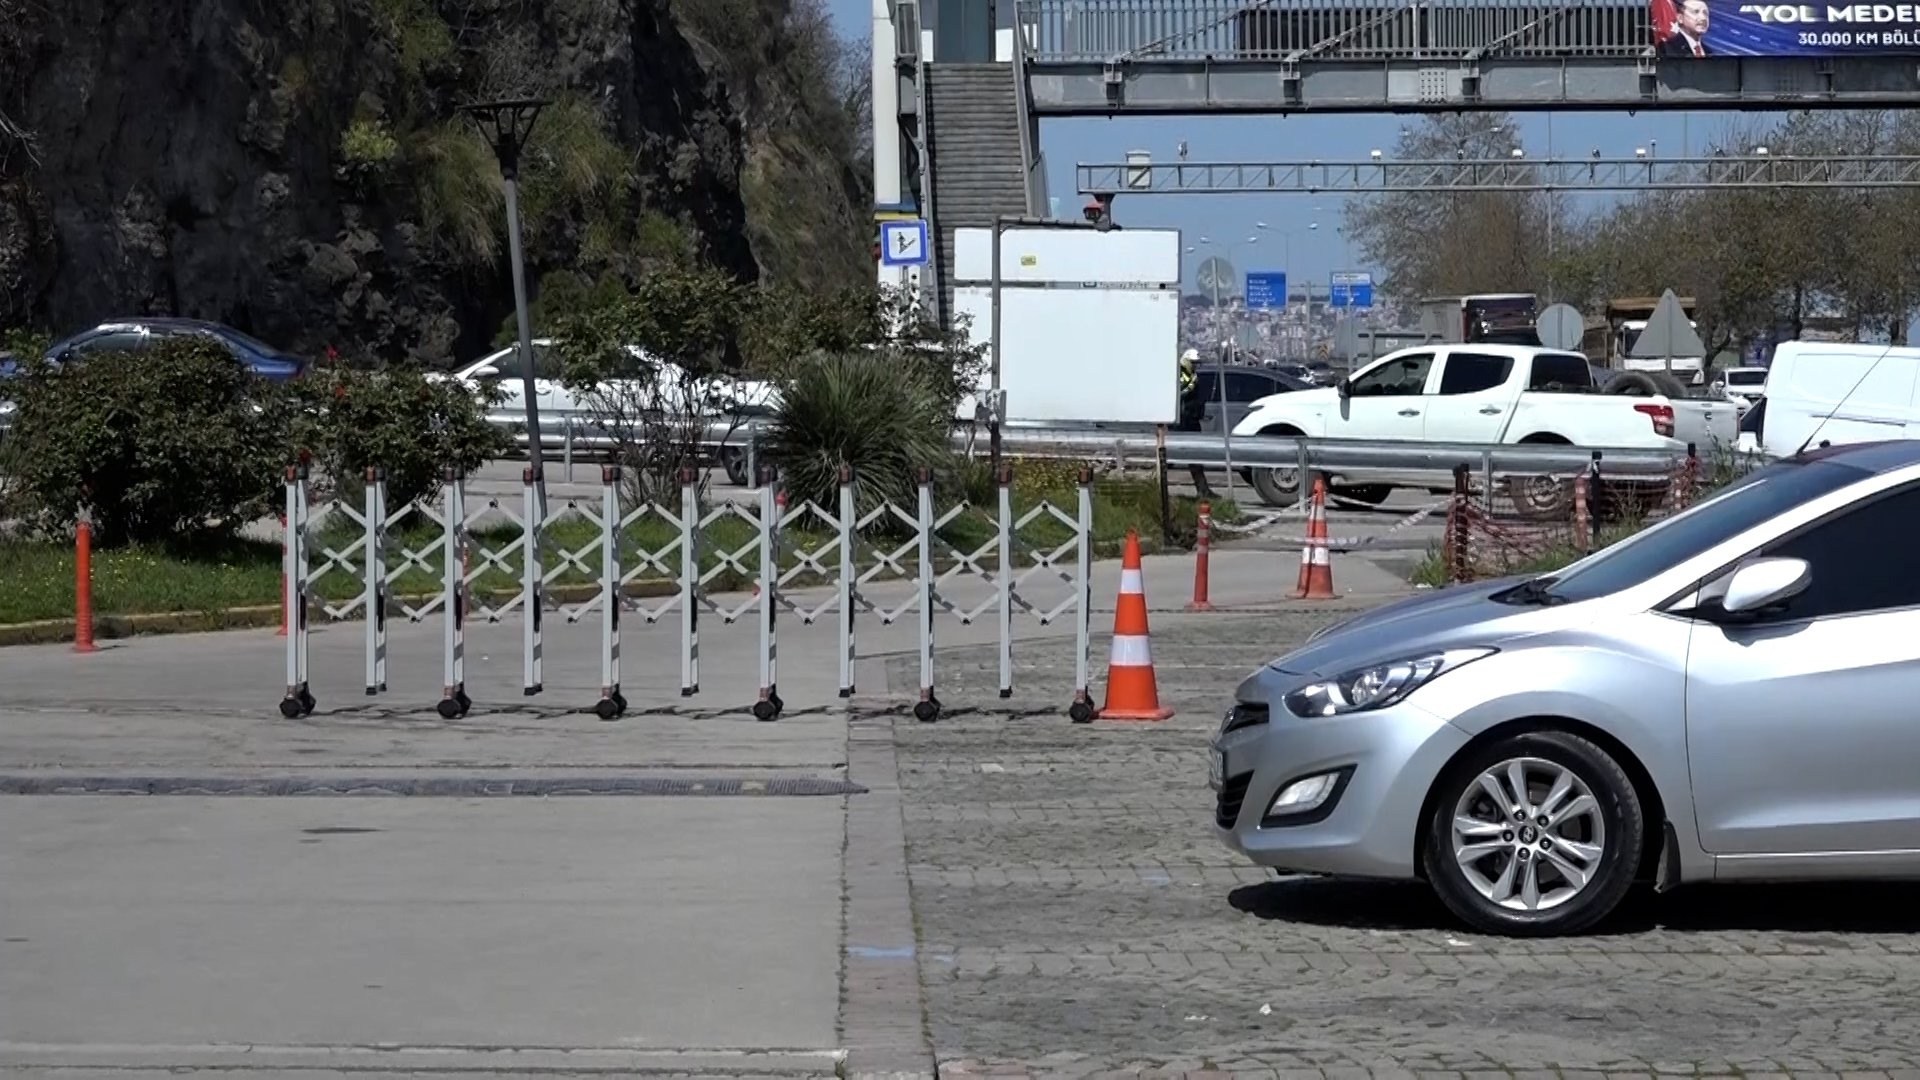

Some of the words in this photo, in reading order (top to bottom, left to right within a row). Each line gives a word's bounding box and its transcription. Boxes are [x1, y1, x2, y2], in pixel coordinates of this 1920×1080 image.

[1827, 4, 1920, 23] MEDE
[1798, 31, 1852, 46] 30.000
[1856, 32, 1878, 46] KM
